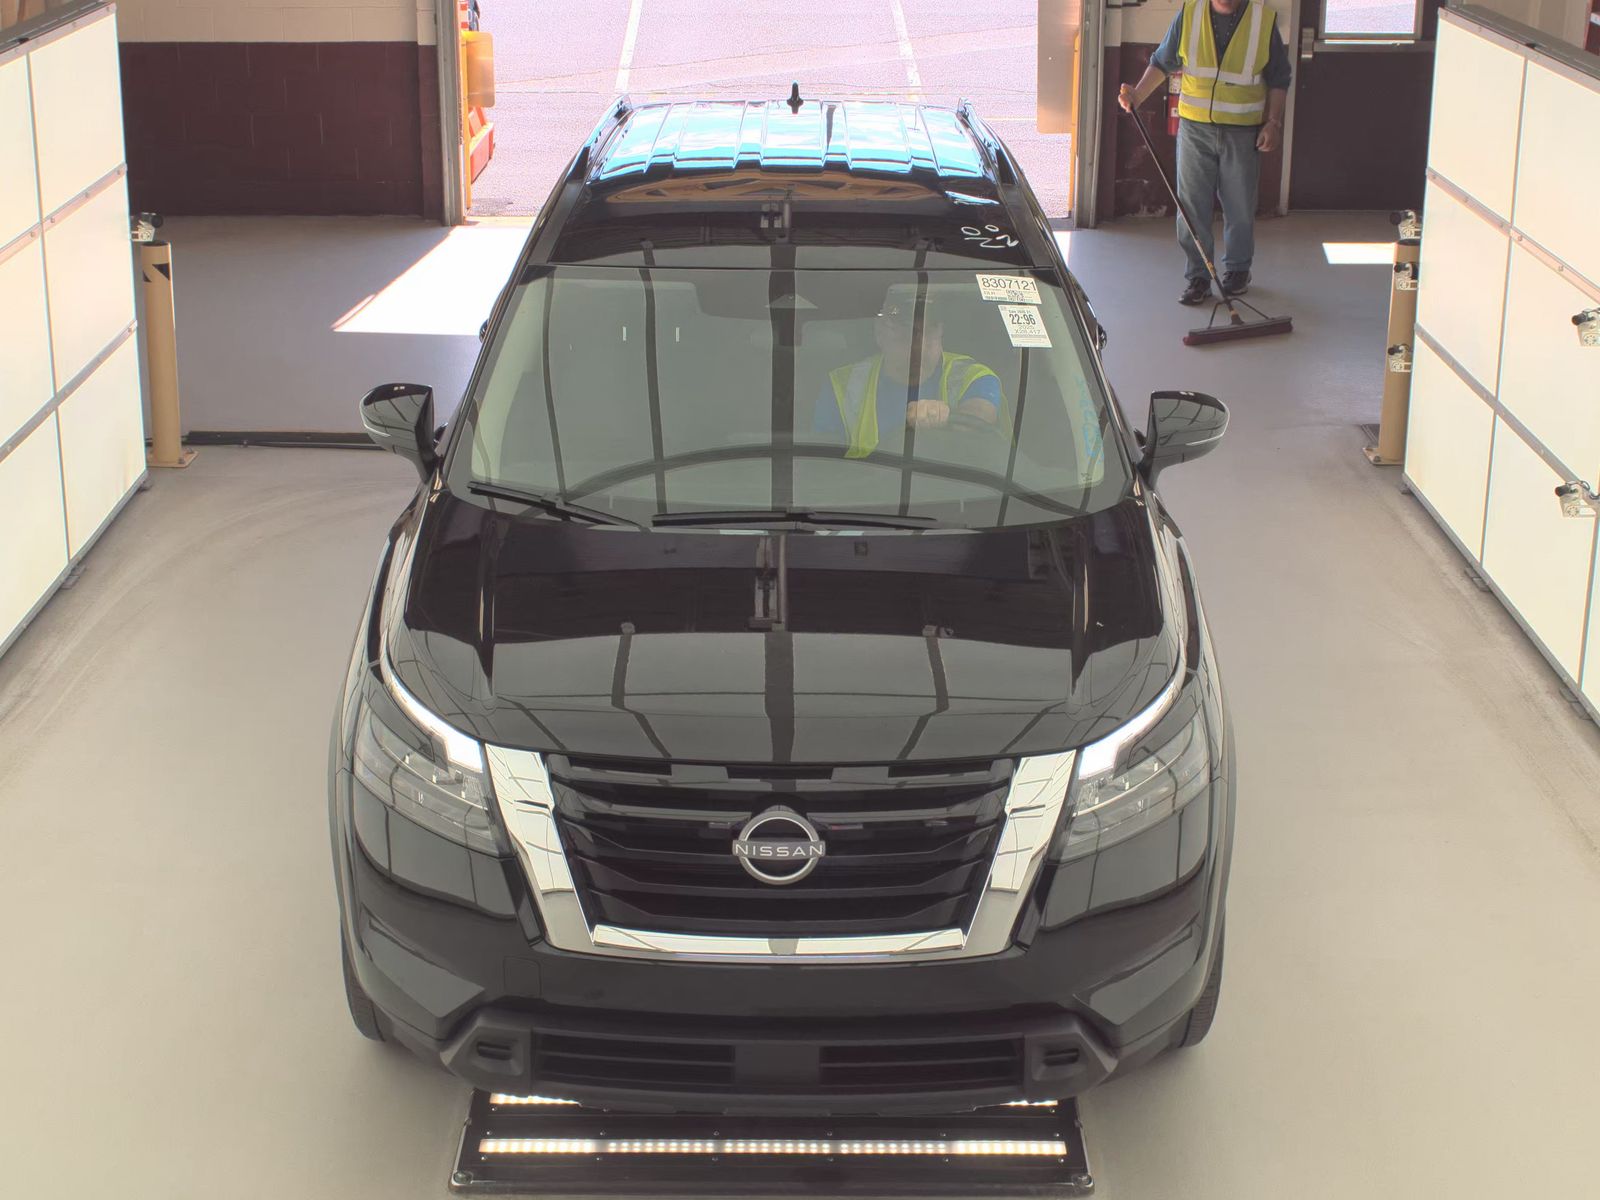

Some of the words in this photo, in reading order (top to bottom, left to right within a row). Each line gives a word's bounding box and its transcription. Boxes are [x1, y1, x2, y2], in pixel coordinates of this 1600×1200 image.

[981, 277, 1037, 291] 8307121
[1009, 313, 1036, 325] 22:96
[735, 844, 823, 857] NISSAN
